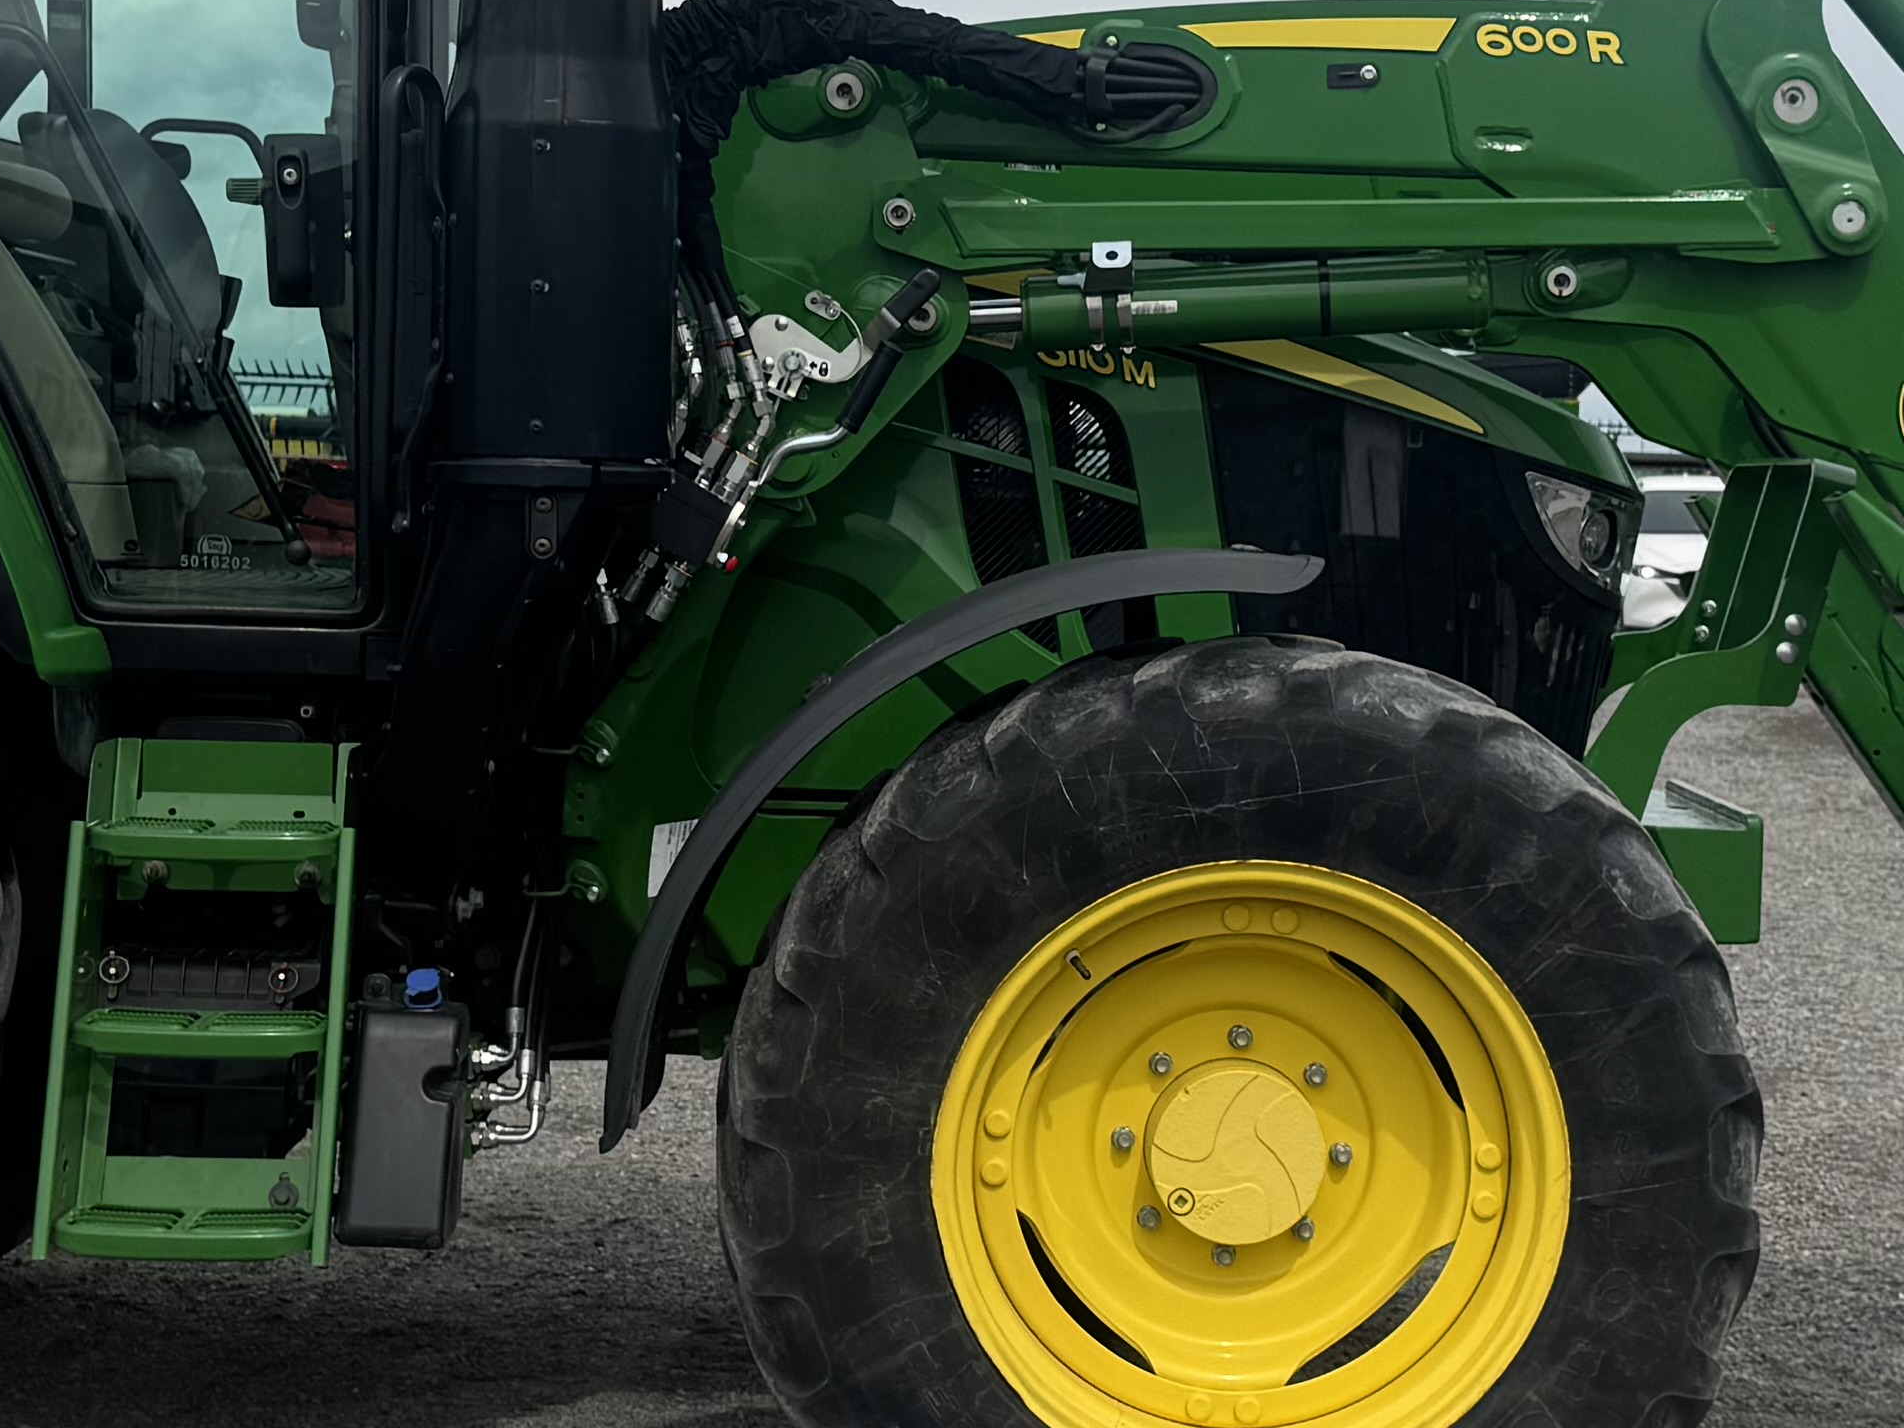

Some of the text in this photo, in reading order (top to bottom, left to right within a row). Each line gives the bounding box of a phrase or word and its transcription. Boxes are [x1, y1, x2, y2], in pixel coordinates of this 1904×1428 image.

[1476, 23, 1625, 65] 600 R
[1122, 353, 1157, 389] M
[180, 554, 251, 570] 5016202
